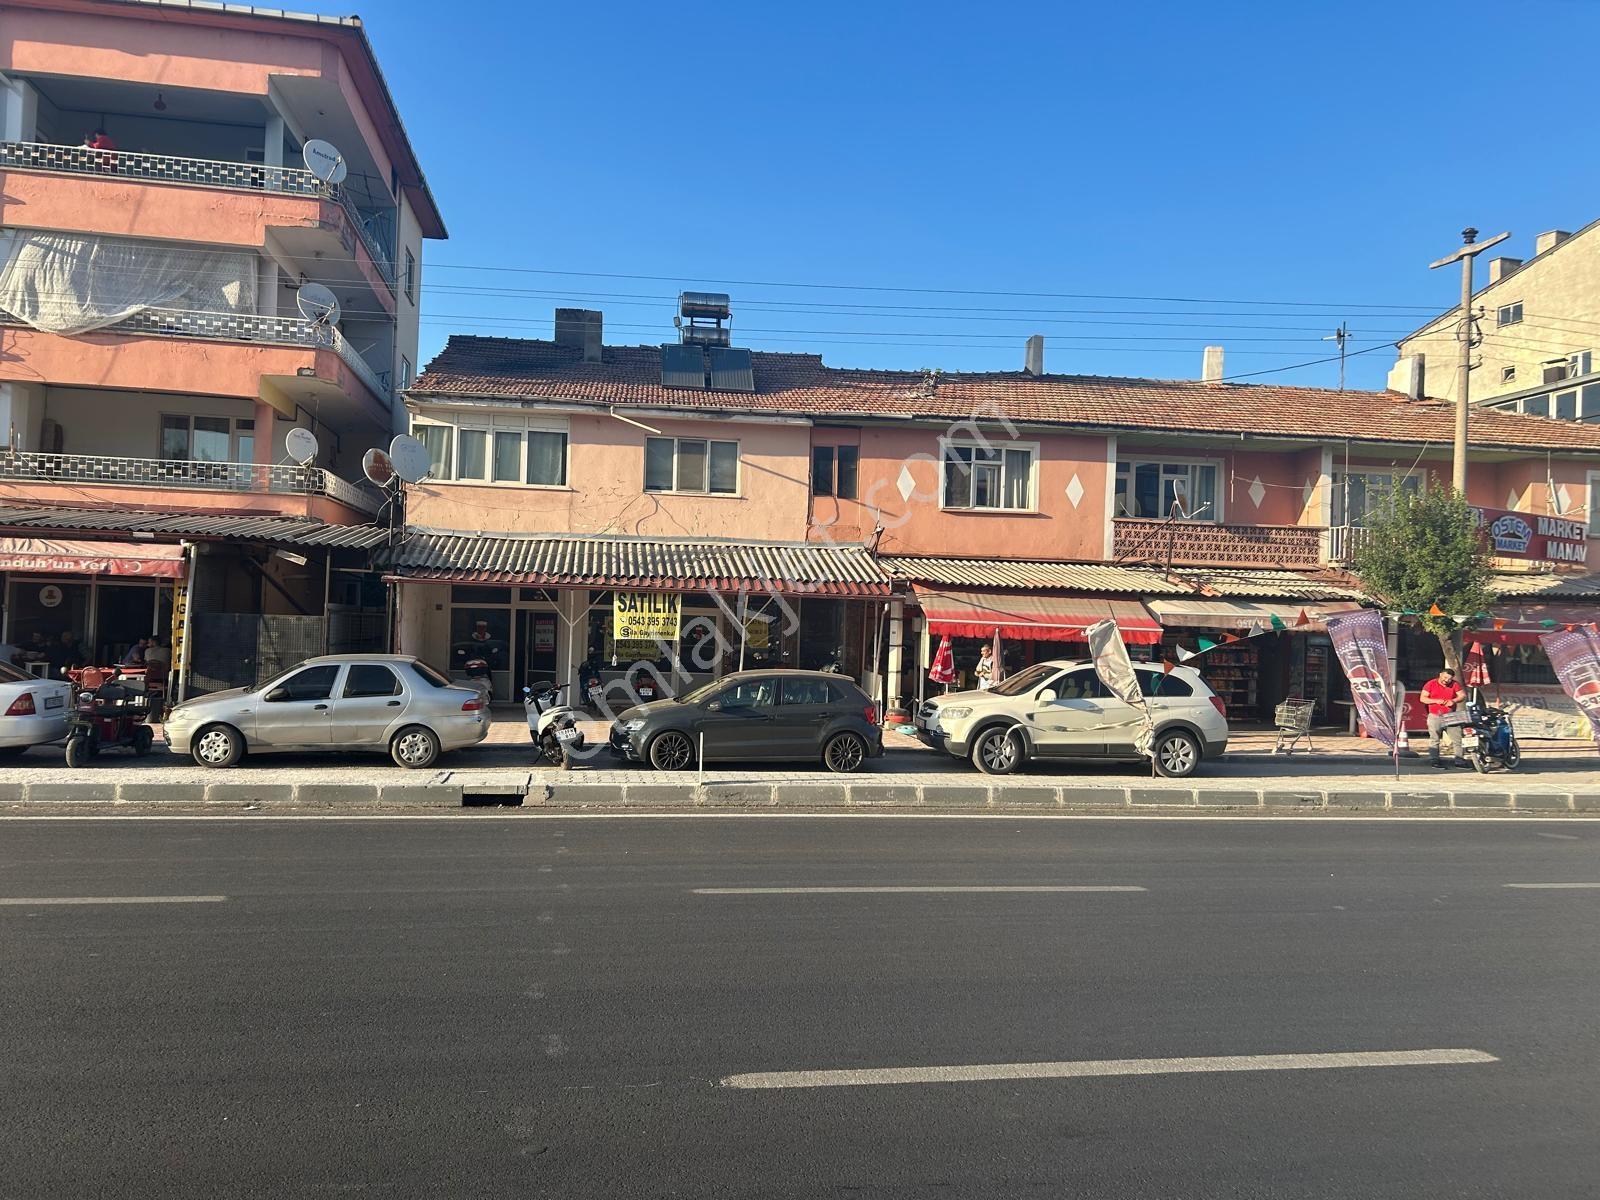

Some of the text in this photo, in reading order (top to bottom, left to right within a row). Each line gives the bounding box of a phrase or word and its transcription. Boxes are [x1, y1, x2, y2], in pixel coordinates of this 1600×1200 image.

[1492, 517, 1531, 539] OSTEM
[1537, 517, 1588, 540] MARKET
[1497, 539, 1528, 552] MARKET
[1546, 541, 1586, 562] MANAV
[617, 592, 678, 614] SATILIK
[628, 616, 678, 627] 0543 395 3743
